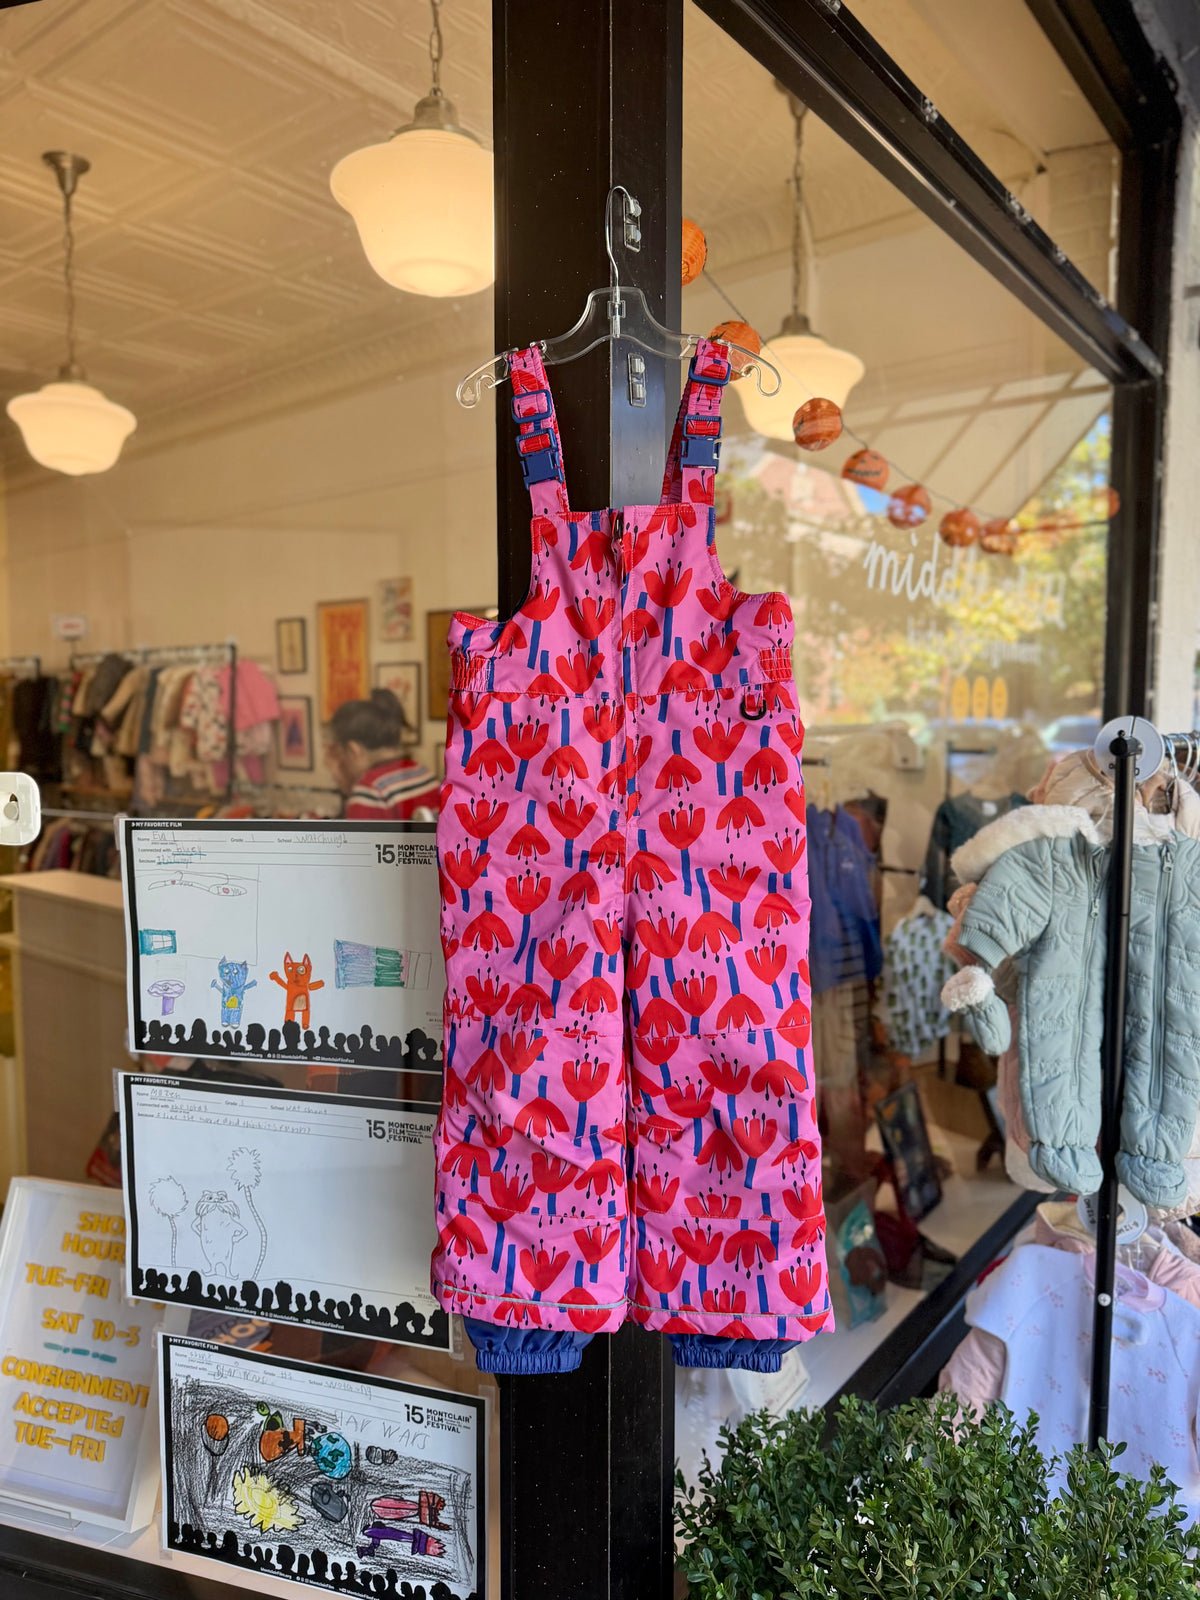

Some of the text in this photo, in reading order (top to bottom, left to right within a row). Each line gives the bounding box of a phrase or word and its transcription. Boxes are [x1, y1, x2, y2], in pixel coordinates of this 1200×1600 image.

[375, 844, 396, 864] 15
[366, 1119, 386, 1140] 15
[388, 1121, 432, 1132] MONTCLAIR
[388, 1135, 423, 1144] FESTIVAL
[77, 1211, 126, 1238] SHO
[61, 1232, 126, 1264] HOUR
[41, 1307, 84, 1335] SAT
[181, 1338, 207, 1348] FAVORITE
[1, 1355, 150, 1409] CONSIGNMENT
[404, 1403, 424, 1425] 15
[426, 1408, 471, 1423] MONTCLAIR
[426, 1415, 444, 1423] FILM
[426, 1421, 461, 1434] FESTIVAL
